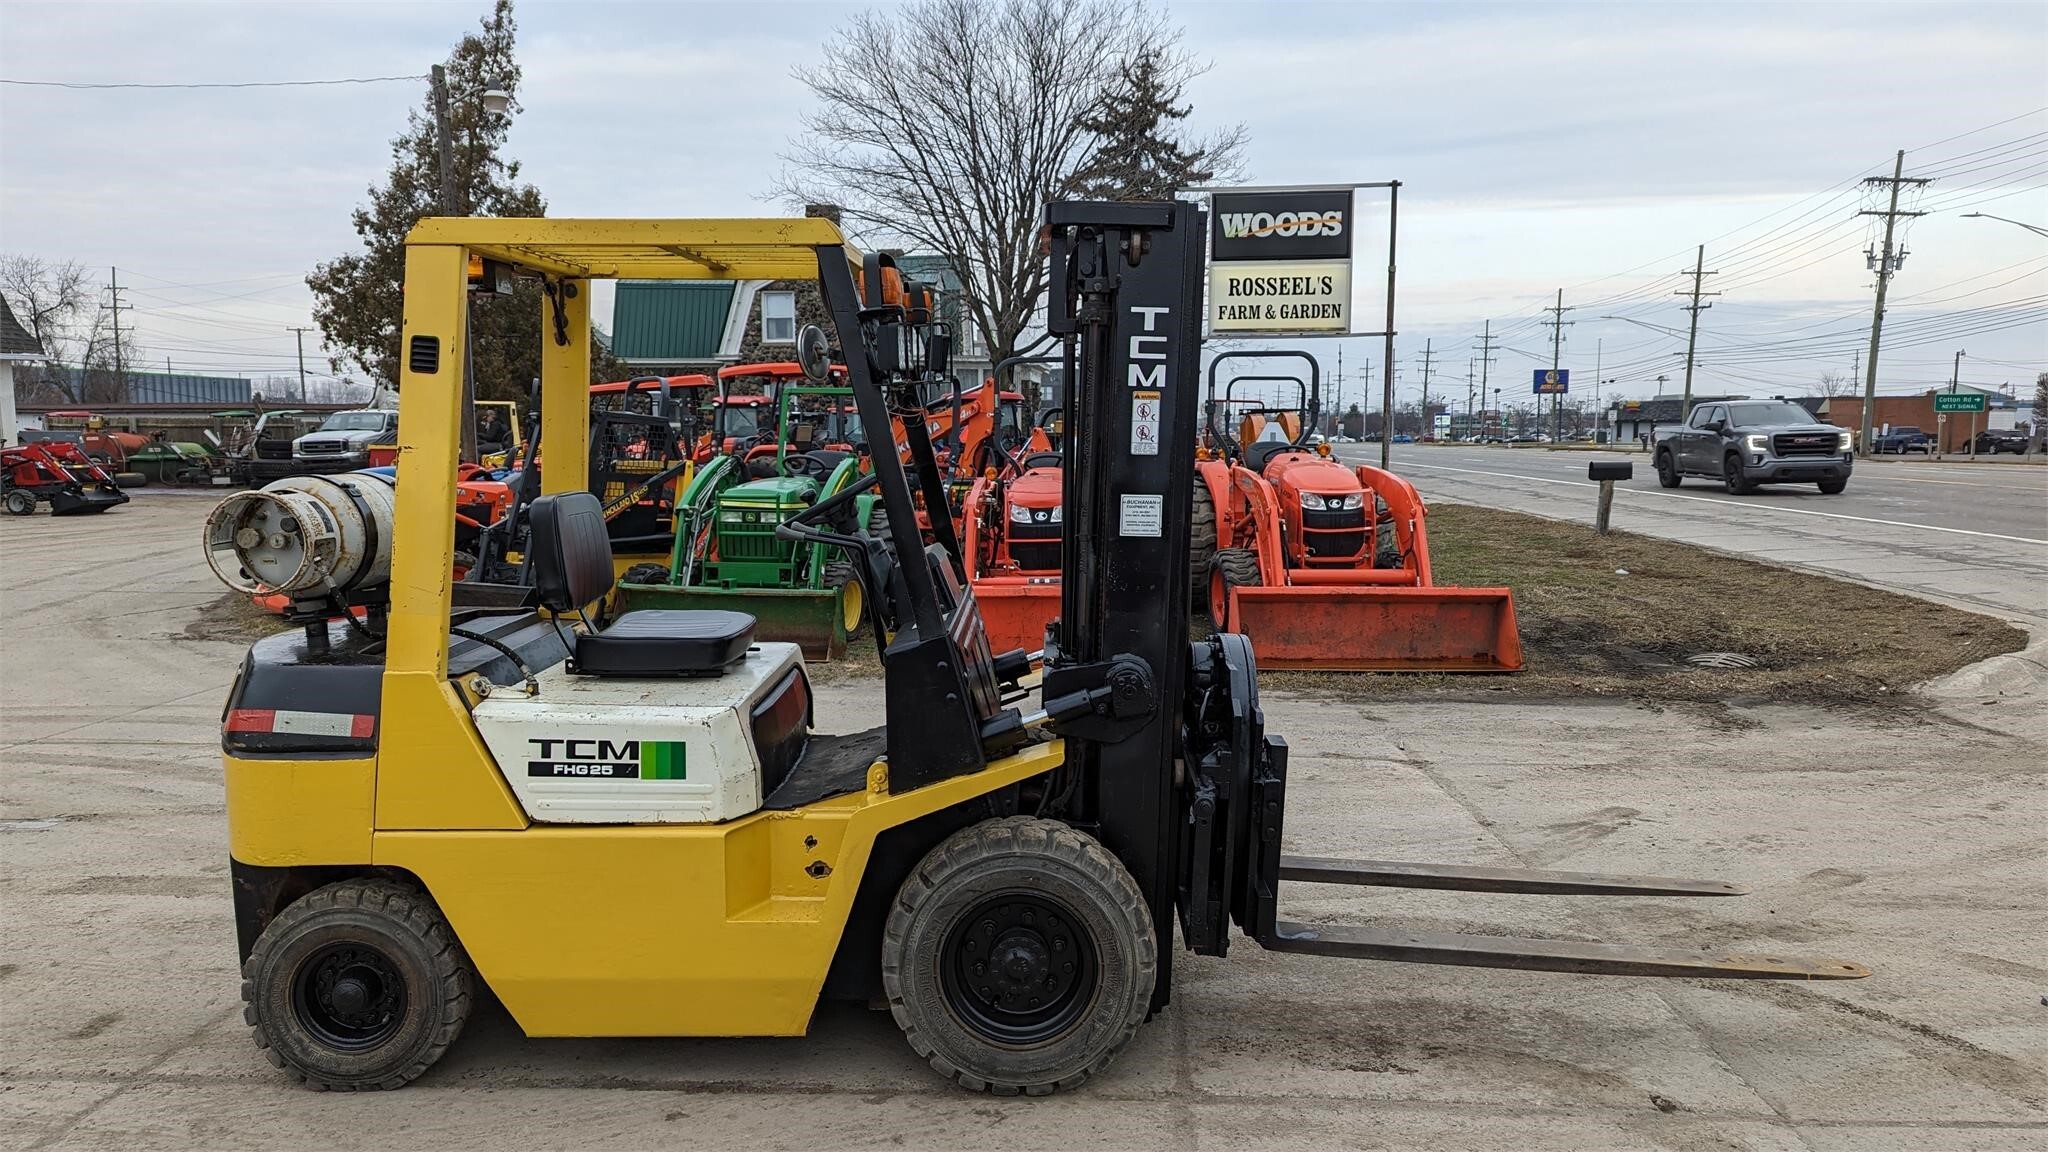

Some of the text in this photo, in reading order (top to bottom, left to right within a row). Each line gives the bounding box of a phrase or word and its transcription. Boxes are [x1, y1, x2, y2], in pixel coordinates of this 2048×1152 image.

[1220, 211, 1343, 238] WOODS
[1228, 276, 1333, 297] ROSSEEL'S
[1218, 303, 1342, 320] FARM & GARDEN
[1128, 306, 1170, 388] TCM
[528, 738, 639, 760] TCM
[553, 764, 614, 775] FHG25
